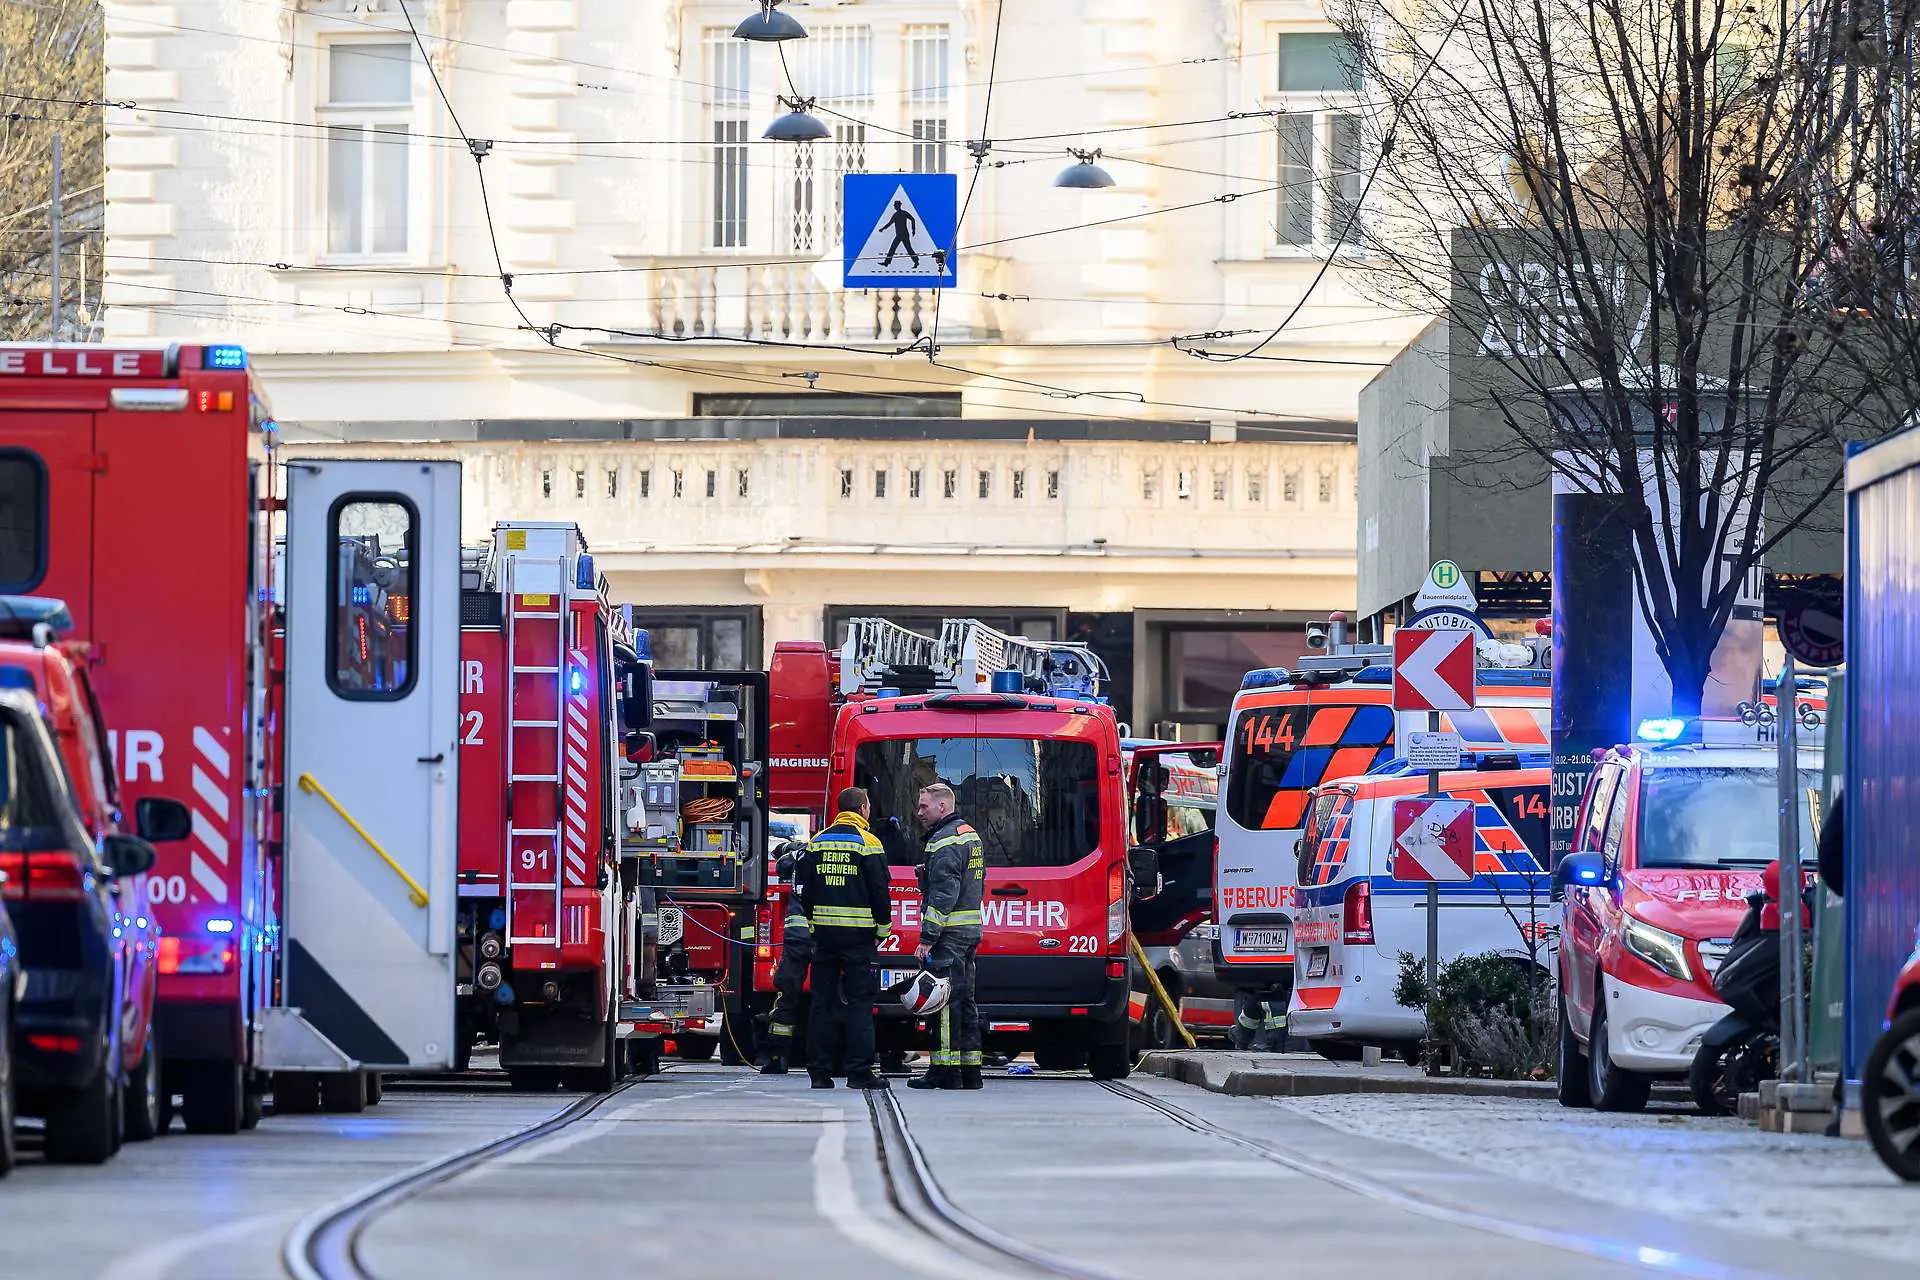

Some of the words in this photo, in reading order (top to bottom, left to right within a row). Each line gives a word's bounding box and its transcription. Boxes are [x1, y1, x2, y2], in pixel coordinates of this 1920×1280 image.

[1438, 566, 1453, 584] H
[1418, 615, 1476, 629] UTOBU
[460, 660, 484, 694] R
[1244, 713, 1295, 755] 144
[768, 757, 829, 768] MAGIRUS
[1512, 793, 1551, 819] 14
[521, 849, 548, 870] 91
[823, 851, 850, 863] BERUFS
[816, 863, 858, 876] FUERWEHR
[825, 875, 845, 887] WIEN
[1235, 885, 1297, 909] BERUFS
[1069, 935, 1098, 954] 220
